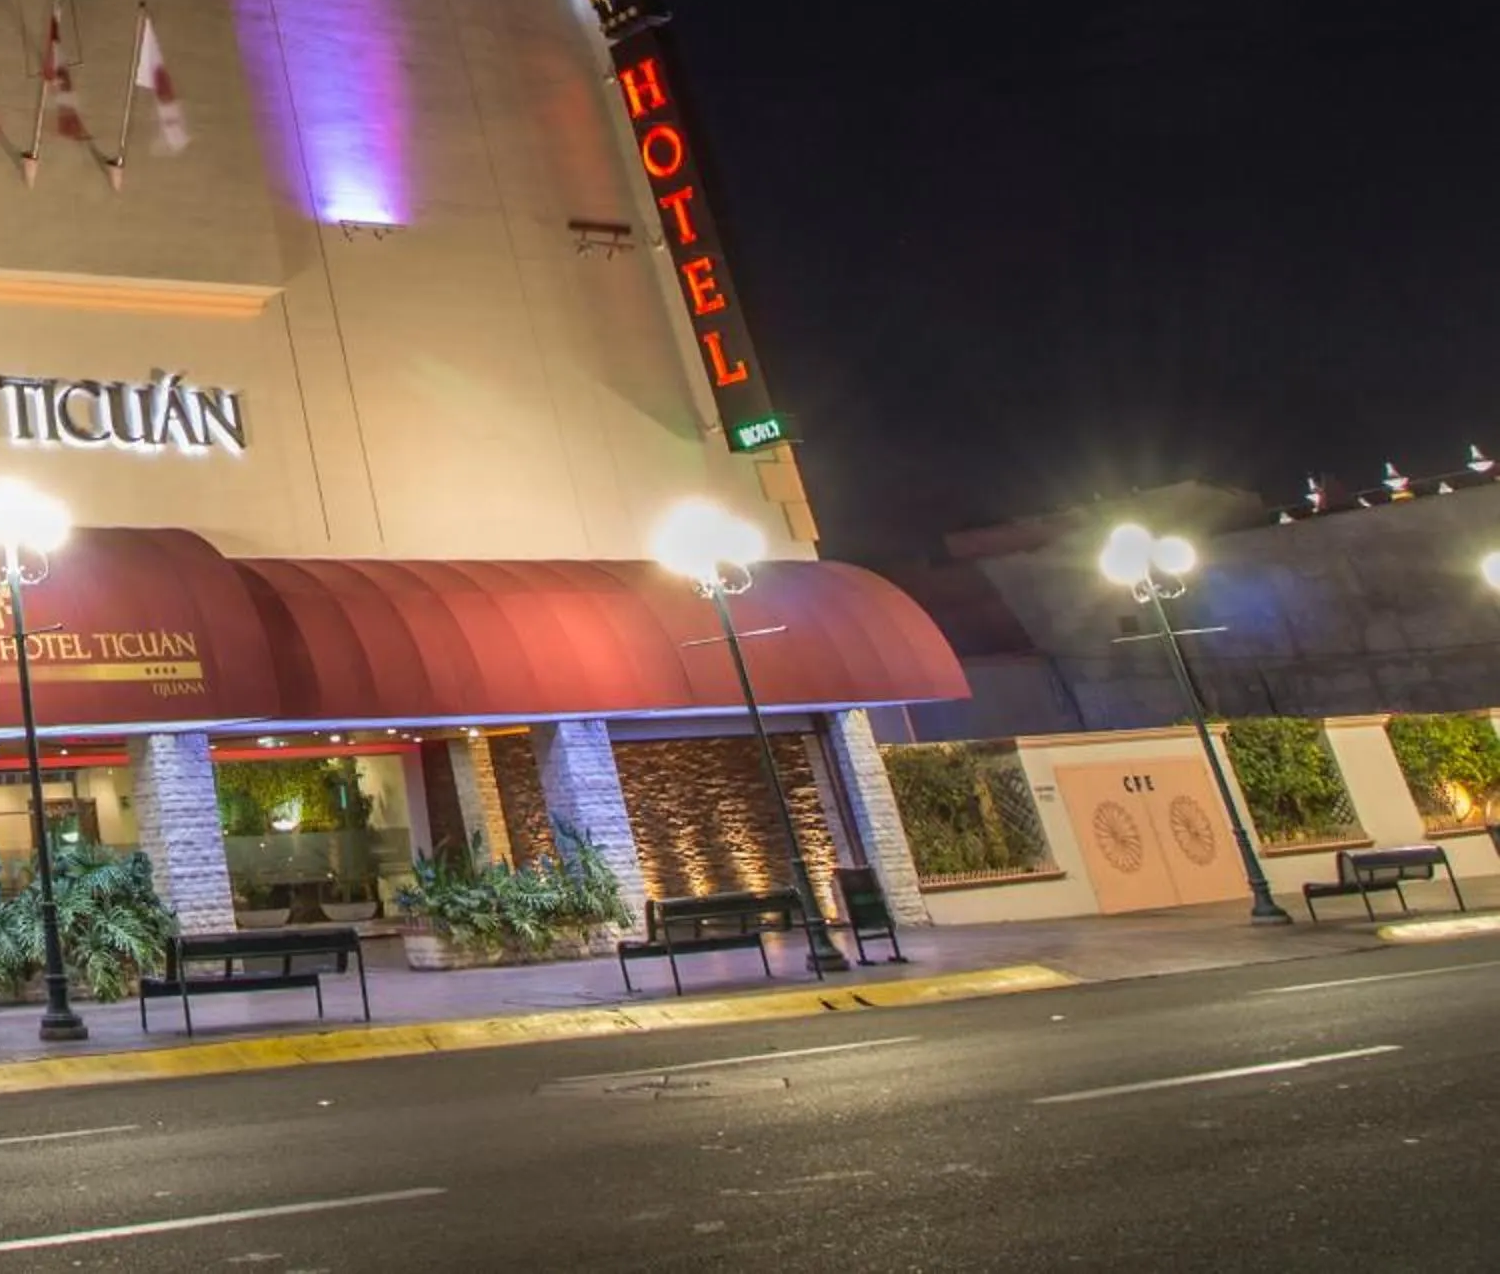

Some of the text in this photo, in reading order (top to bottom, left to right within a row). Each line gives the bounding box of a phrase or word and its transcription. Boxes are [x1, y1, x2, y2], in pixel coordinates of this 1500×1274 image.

[620, 58, 748, 387] HOTEL
[152, 679, 205, 699] TIJUANA
[1123, 775, 1155, 793] CFE
